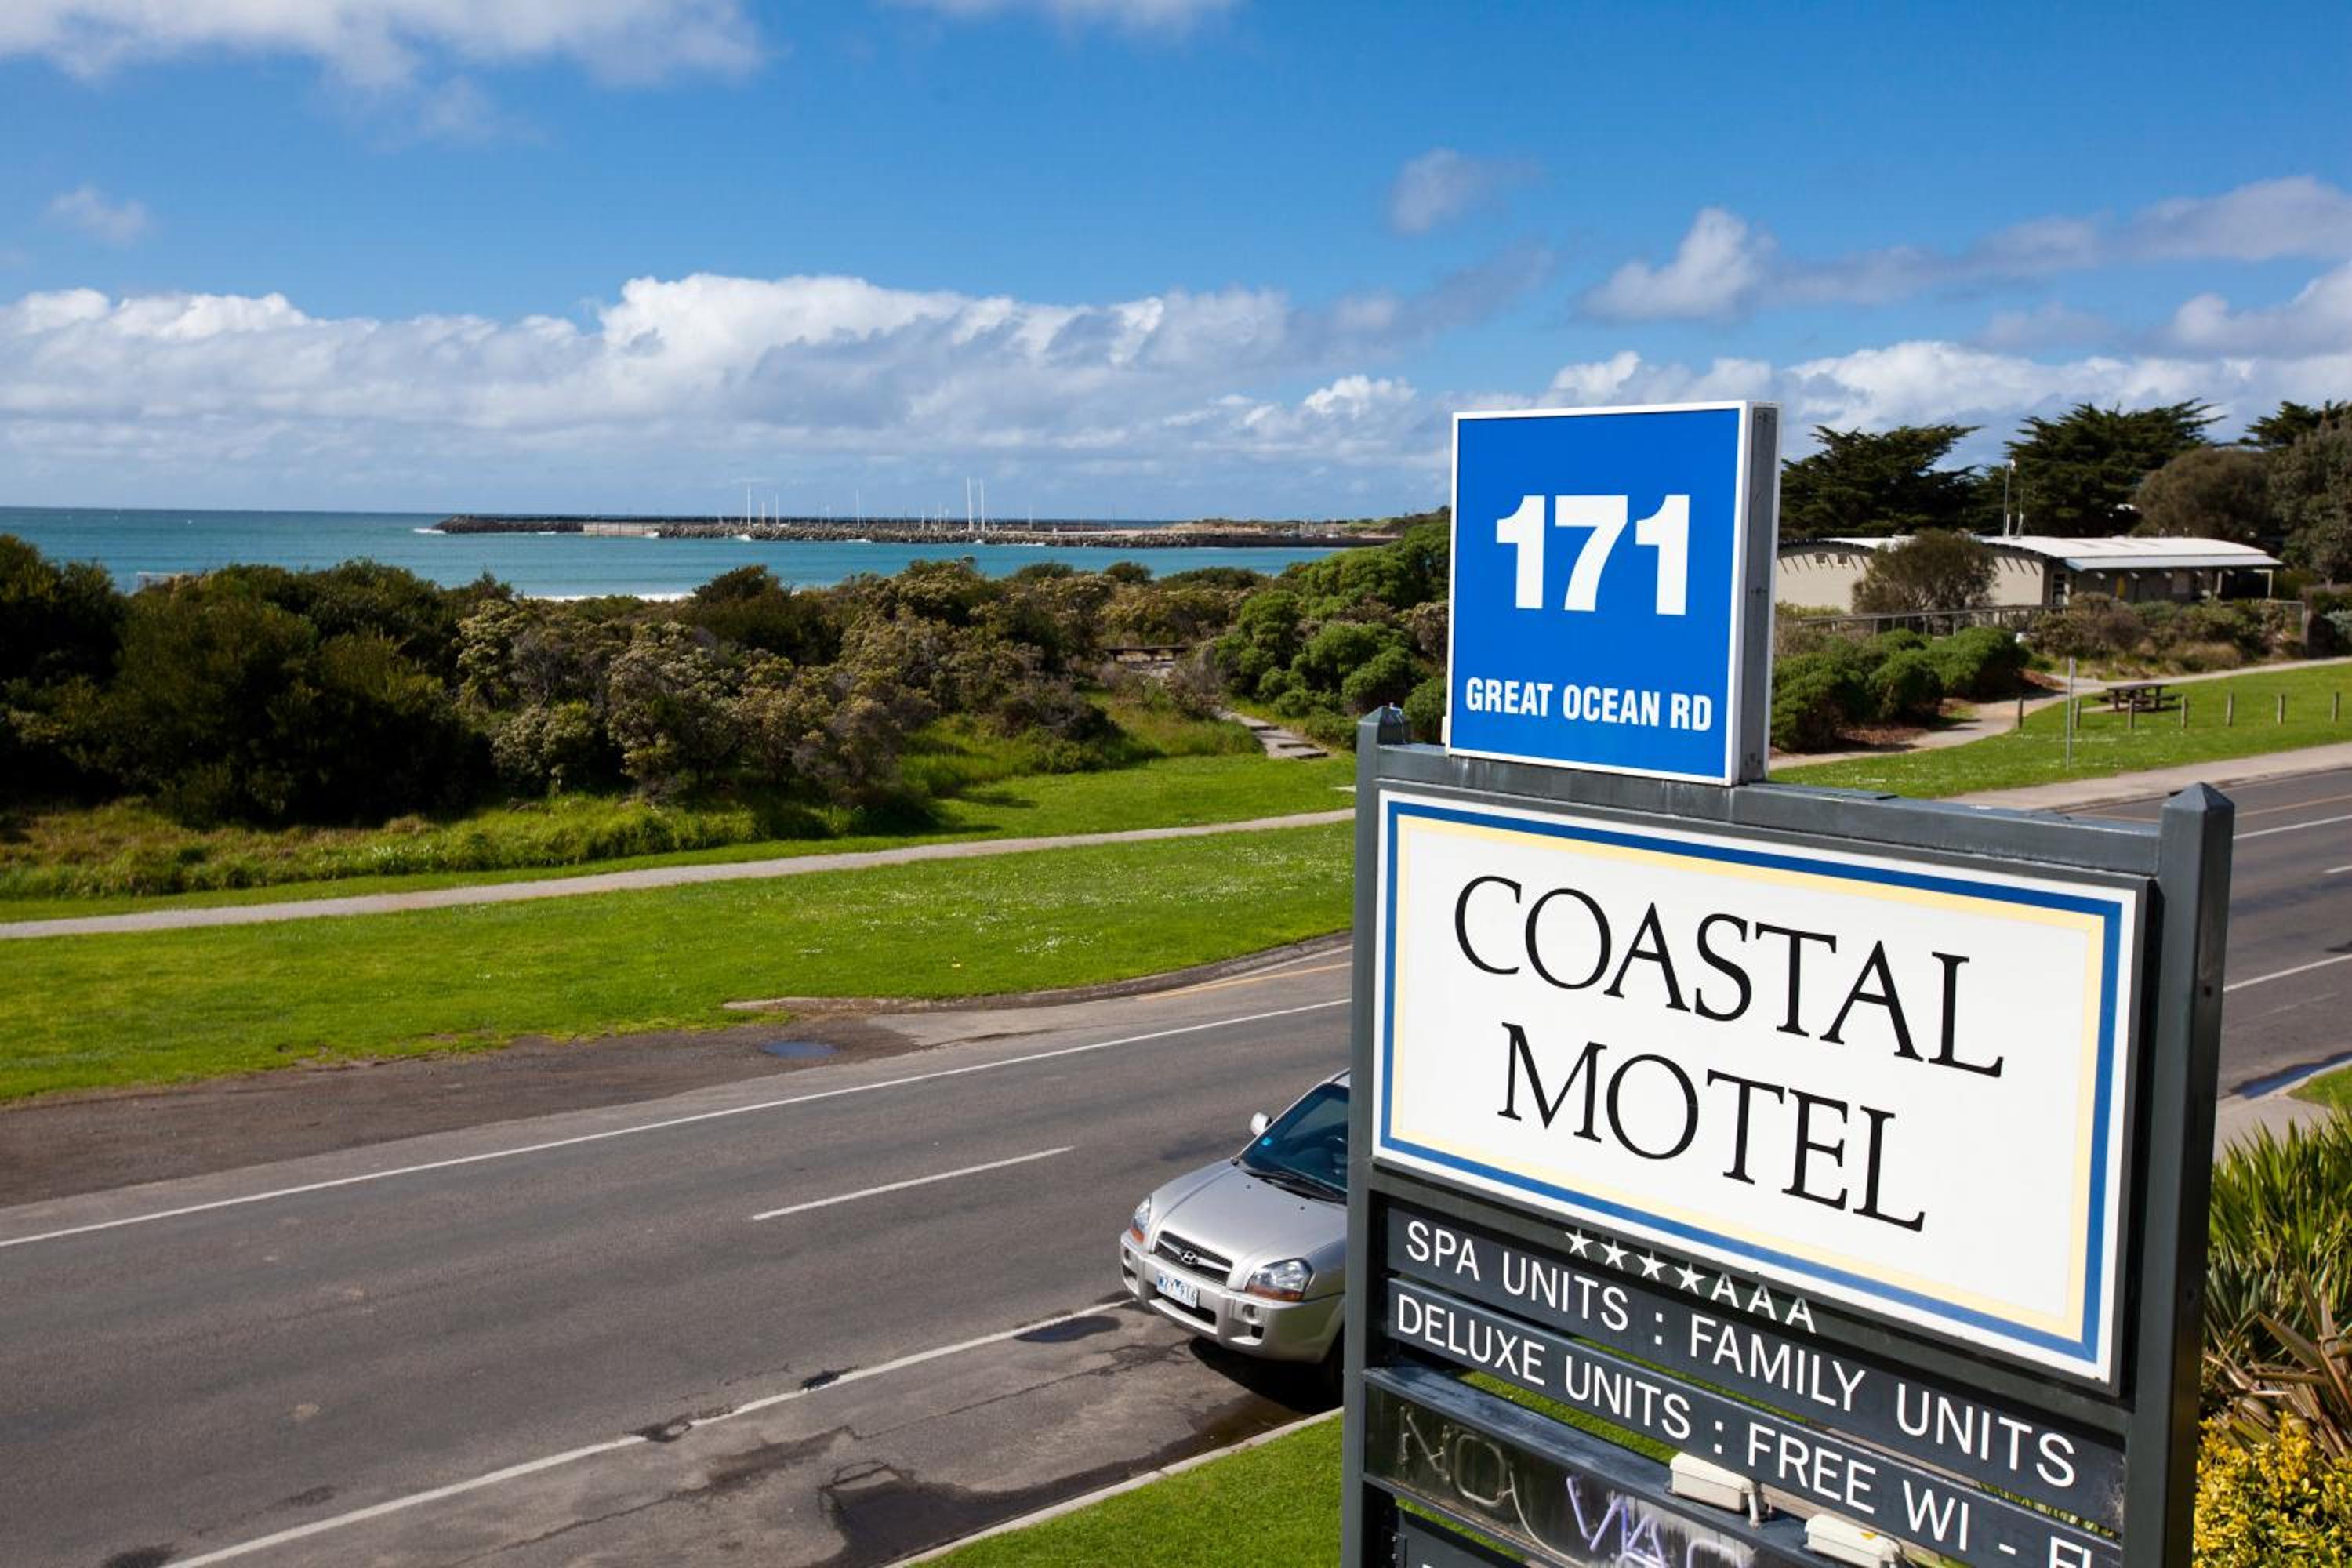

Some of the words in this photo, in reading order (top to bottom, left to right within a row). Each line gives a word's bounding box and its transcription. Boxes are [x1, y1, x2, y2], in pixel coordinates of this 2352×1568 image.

[1496, 495, 1690, 615] 171
[1466, 677, 1553, 717] GREAT
[1563, 684, 1660, 727] OCEAN
[1670, 693, 1712, 731] RD
[1454, 876, 2004, 1078] COASTAL
[1497, 1022, 1926, 1232] MOTEL
[1398, 1294, 1546, 1386] DELUXE
[1566, 1356, 1691, 1440] UNITS
[1748, 1421, 1877, 1515] FREE
[1902, 1479, 1969, 1552] WI
[1406, 1221, 1480, 1282] SPA
[1503, 1251, 1629, 1331] UNITS
[1690, 1313, 1867, 1412] FAMILY
[1896, 1382, 2076, 1488] UNITS
